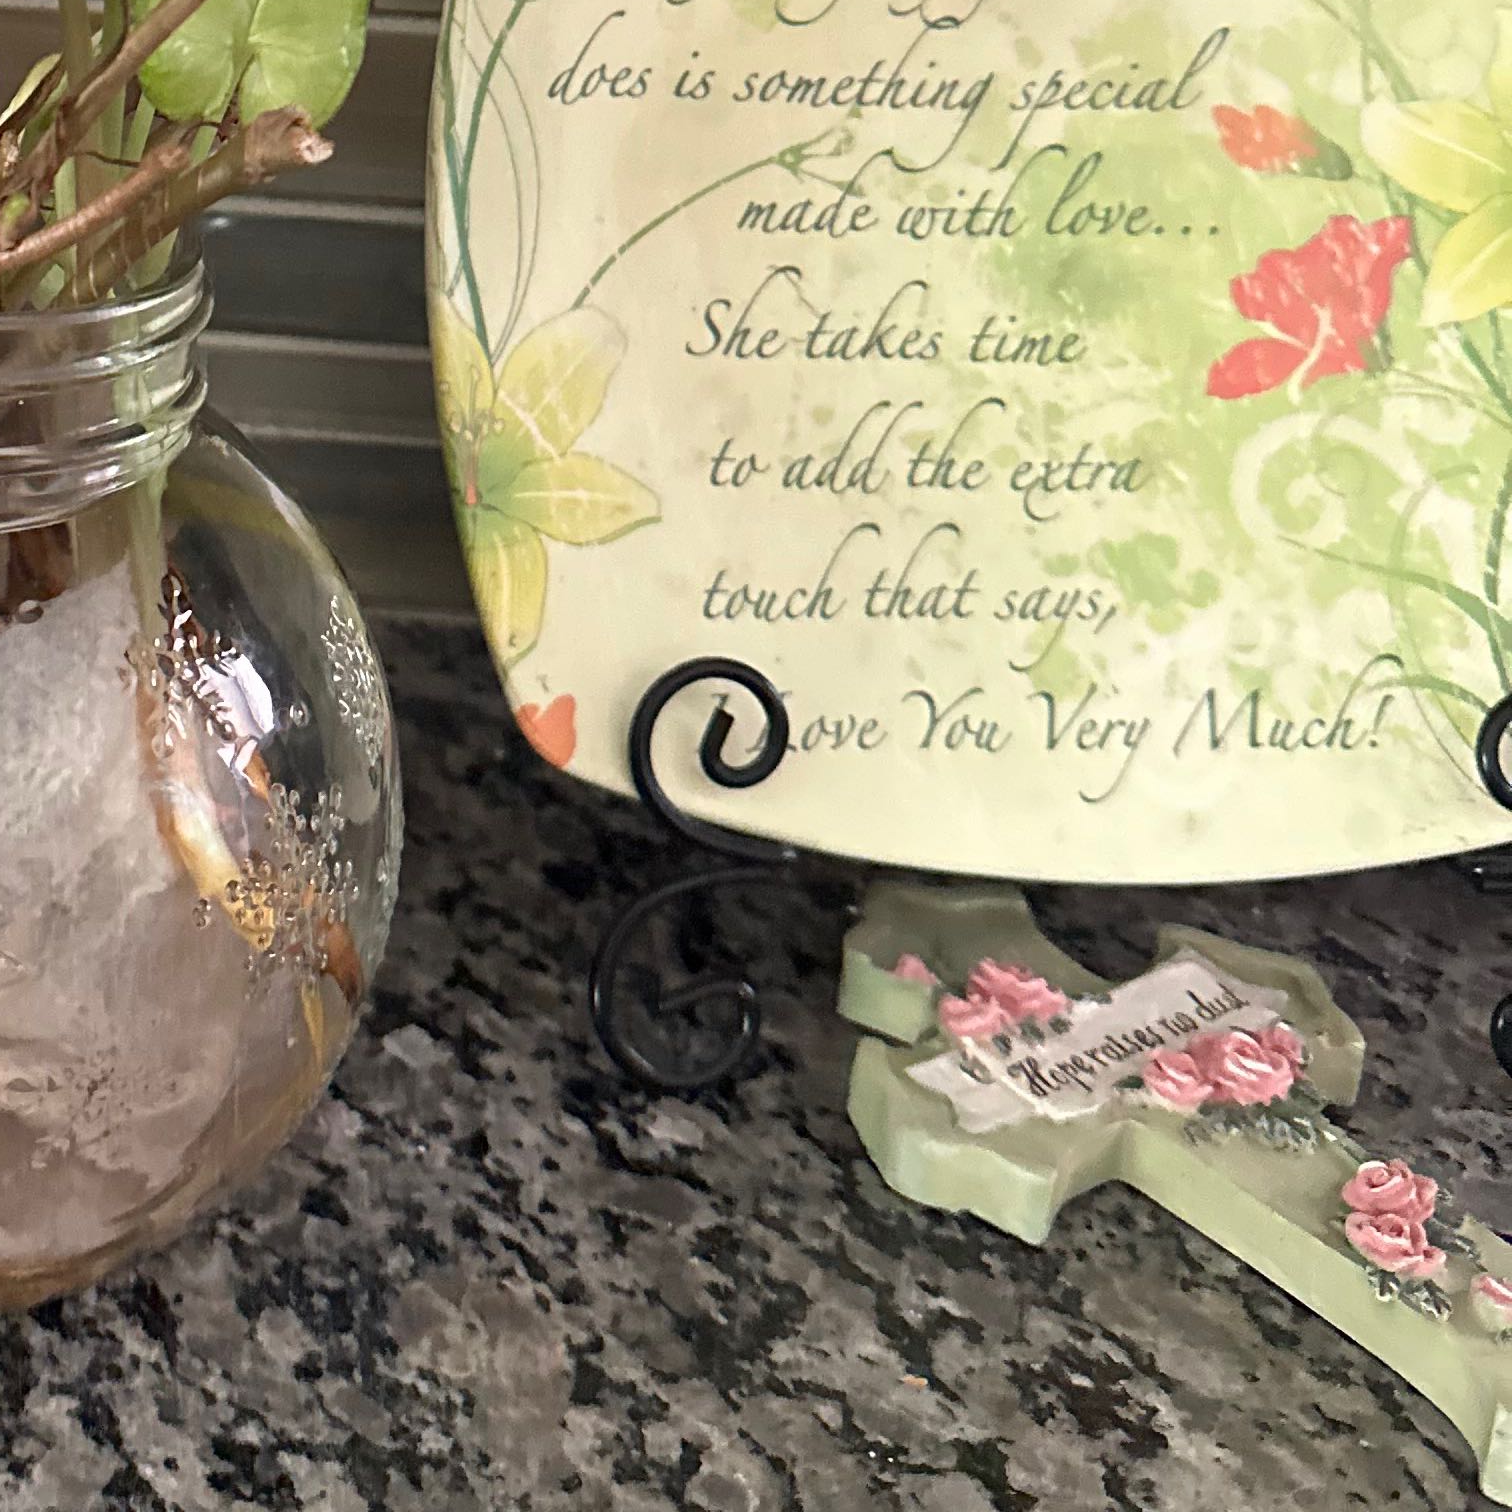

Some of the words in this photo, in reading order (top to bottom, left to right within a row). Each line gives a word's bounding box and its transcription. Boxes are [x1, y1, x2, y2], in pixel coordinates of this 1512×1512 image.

[547, 9, 653, 106] does
[673, 50, 716, 101] is
[732, 15, 995, 173] something
[990, 26, 1231, 172] special
[736, 149, 880, 239] made
[895, 143, 1068, 240] with
[1044, 151, 1221, 236] love...
[685, 265, 804, 359] She
[804, 279, 944, 361] takes
[968, 314, 1090, 367] time
[709, 438, 771, 488] to
[781, 400, 924, 495] add
[906, 396, 1006, 489] the
[1009, 442, 1151, 521] extra
[701, 521, 881, 622] touch
[863, 521, 982, 619] that
[992, 584, 1121, 673] says,
[901, 686, 1014, 754] You
[1025, 681, 1152, 804] Very
[1171, 652, 1394, 761] Much!
[1006, 1054, 1098, 1098] Hope
[1083, 1025, 1166, 1069] raises
